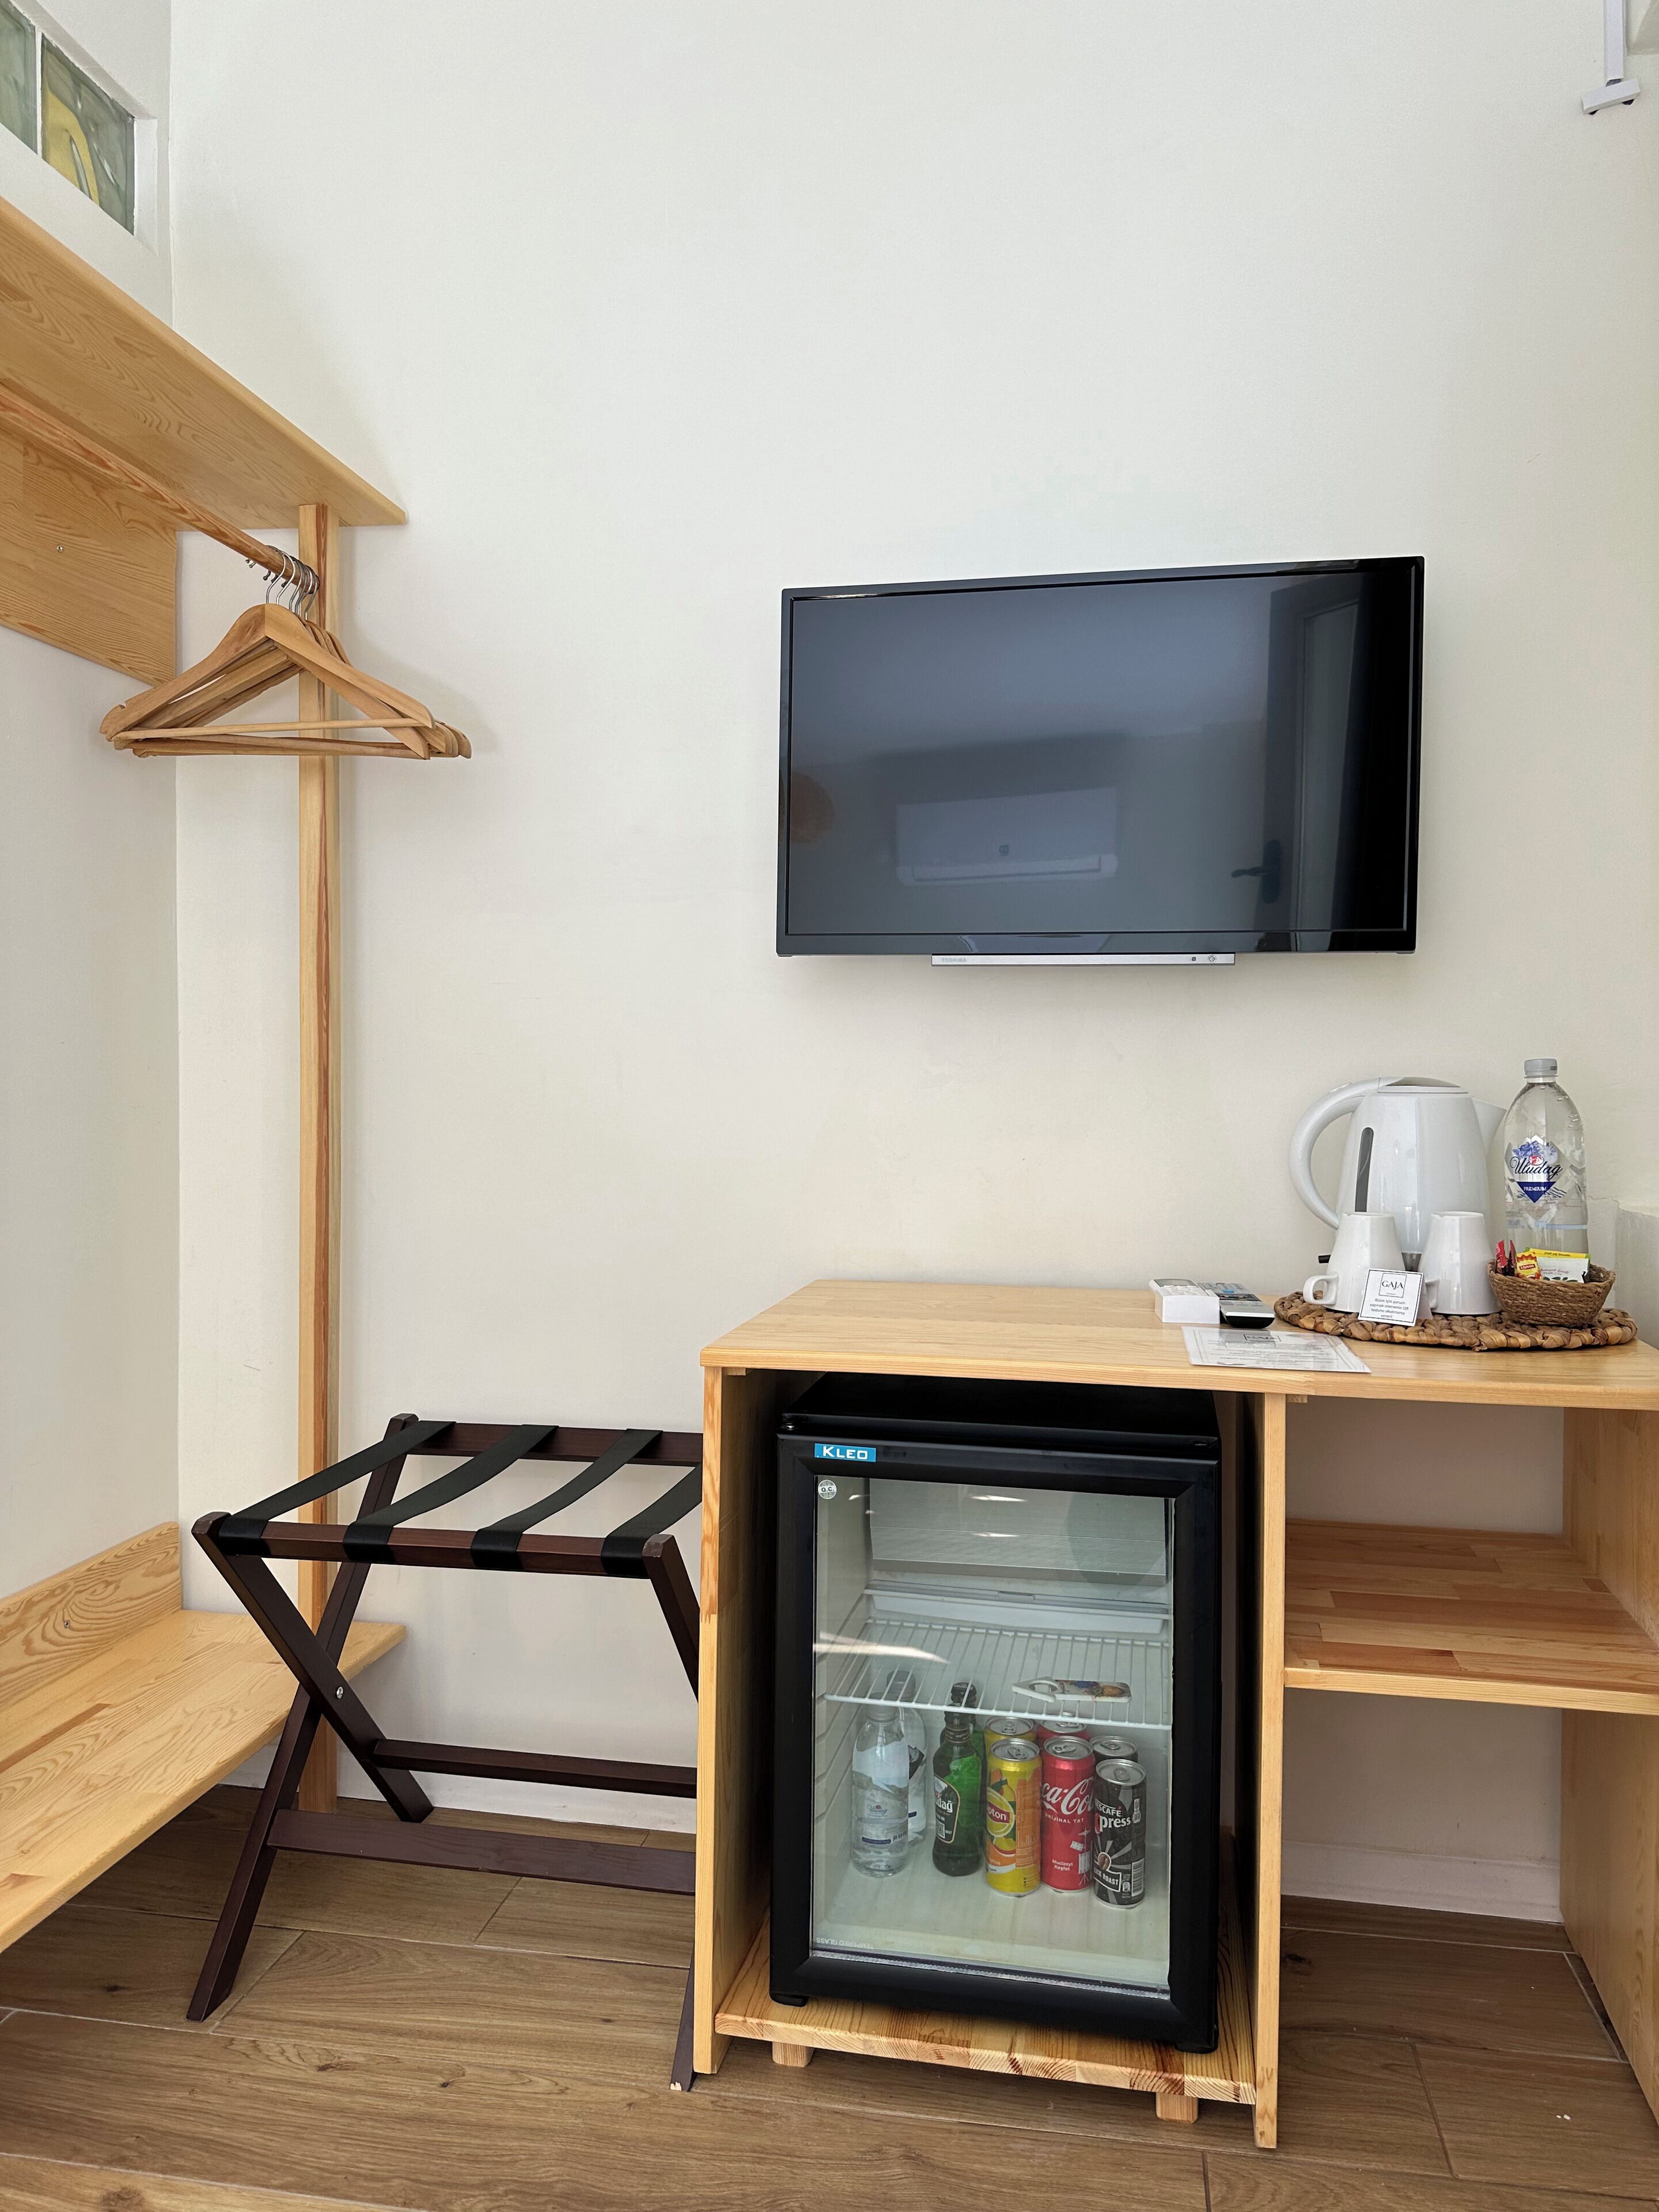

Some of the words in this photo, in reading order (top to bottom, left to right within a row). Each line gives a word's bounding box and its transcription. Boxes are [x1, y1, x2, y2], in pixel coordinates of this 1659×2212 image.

[1509, 1156, 1563, 1181] Uludağ
[1382, 1280, 1403, 1290] GAJA
[823, 1446, 868, 1460] KLEO
[1041, 1777, 1094, 1815] ca-Col
[936, 1797, 953, 1813] dağ
[987, 1804, 1007, 1821] pton
[1103, 1873, 1119, 1886] ROAST
[816, 1937, 838, 1945] GLASS
[839, 1940, 874, 1949] TEMPERED
